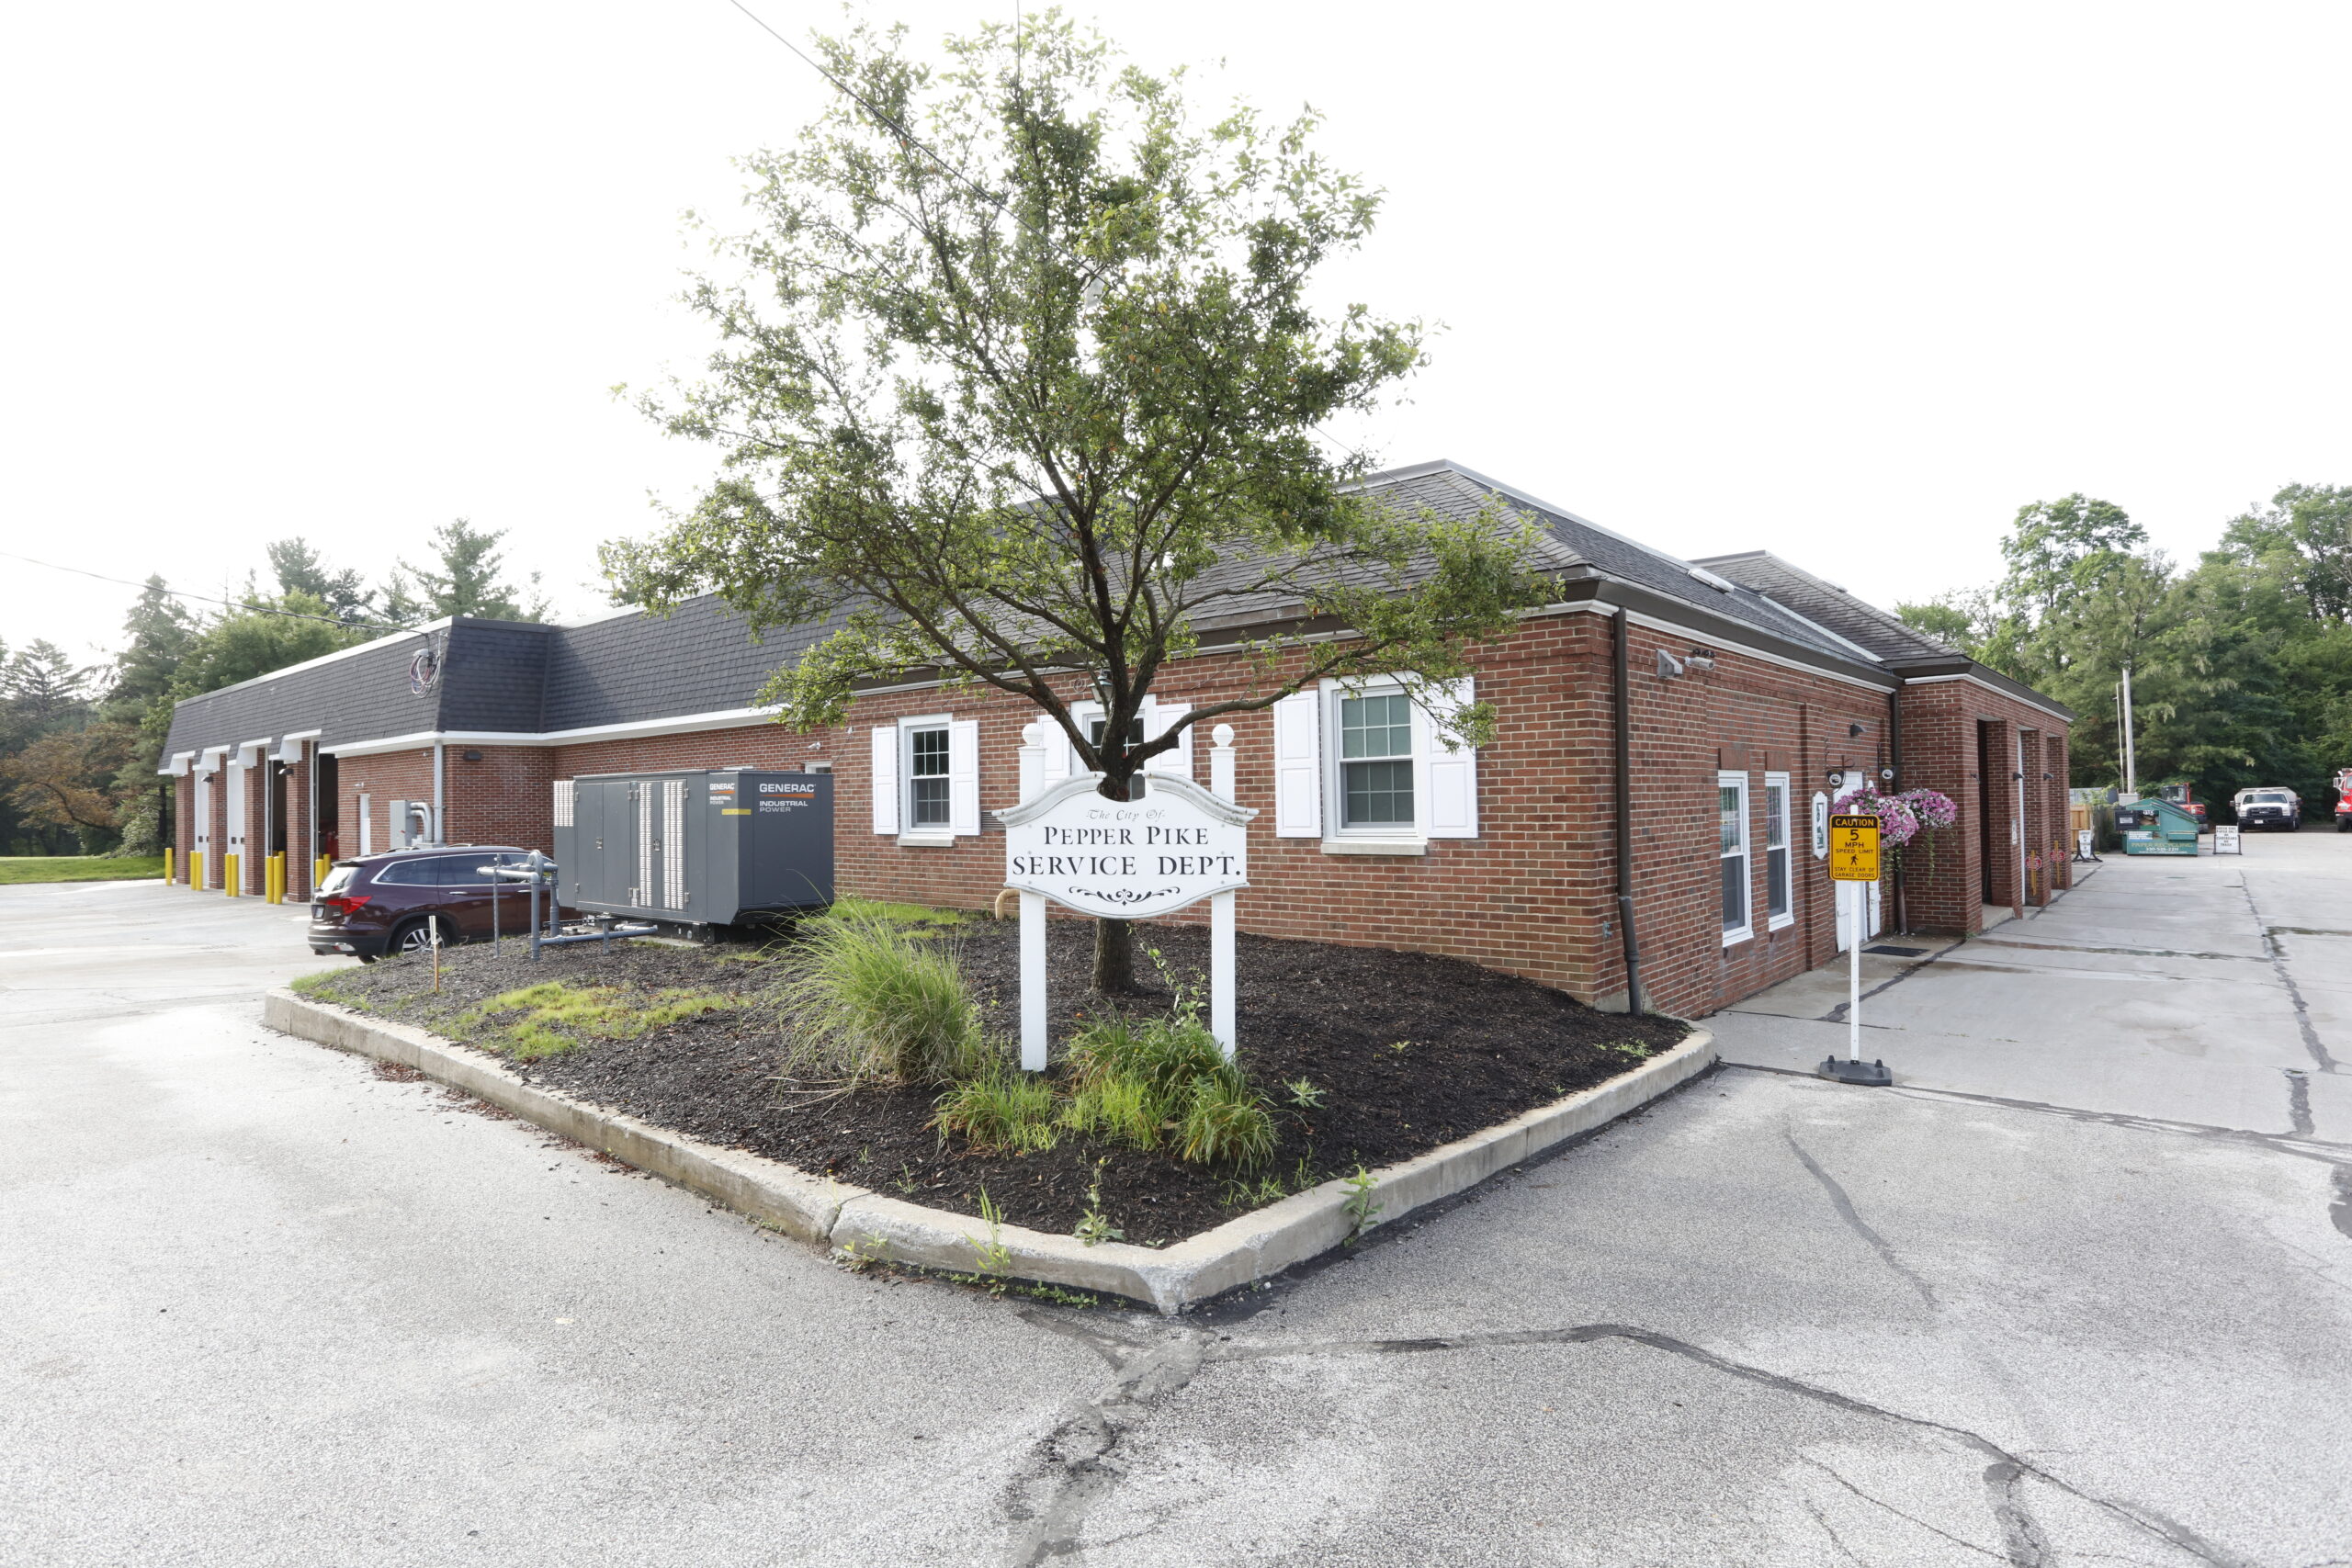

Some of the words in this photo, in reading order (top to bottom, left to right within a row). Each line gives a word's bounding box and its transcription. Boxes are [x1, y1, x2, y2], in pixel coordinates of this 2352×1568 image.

[759, 783, 815, 793] GENERAC
[1116, 808, 1139, 820] City
[1836, 818, 1874, 827] CAUTION
[1044, 826, 1135, 845] PEPPER
[1146, 826, 1209, 845] PIKE
[1850, 829, 1860, 840] 5
[1012, 856, 1136, 875] SERVICE
[1158, 856, 1241, 875] DEPT.
